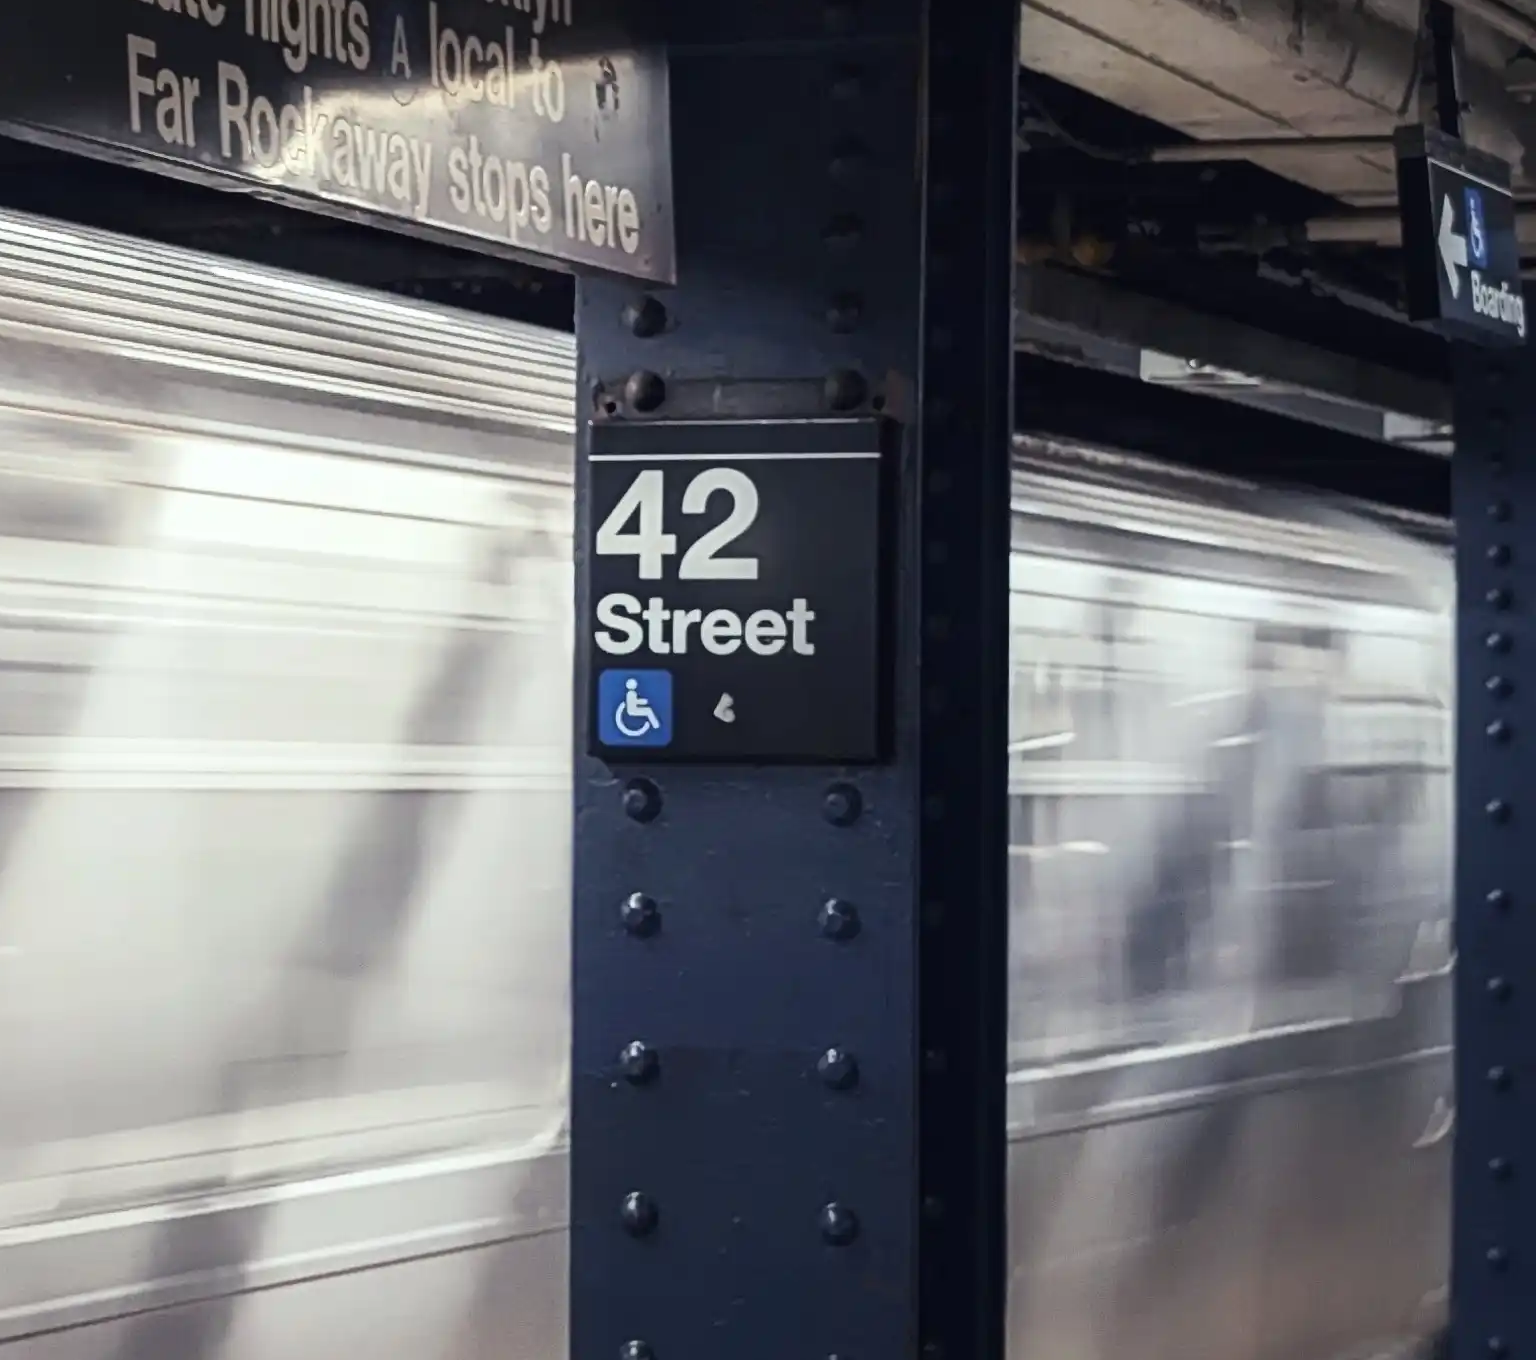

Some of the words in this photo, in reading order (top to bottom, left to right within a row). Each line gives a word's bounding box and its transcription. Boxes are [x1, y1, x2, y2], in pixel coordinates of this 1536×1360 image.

[390, 15, 412, 80] A
[428, 0, 515, 110] local
[530, 37, 565, 122] to
[125, 33, 201, 148] Far
[217, 59, 432, 219] Rockaway
[449, 145, 551, 242] stops
[561, 153, 640, 255] here
[1470, 269, 1526, 338] Boarding
[595, 467, 760, 581] 42
[593, 592, 817, 656] Street
